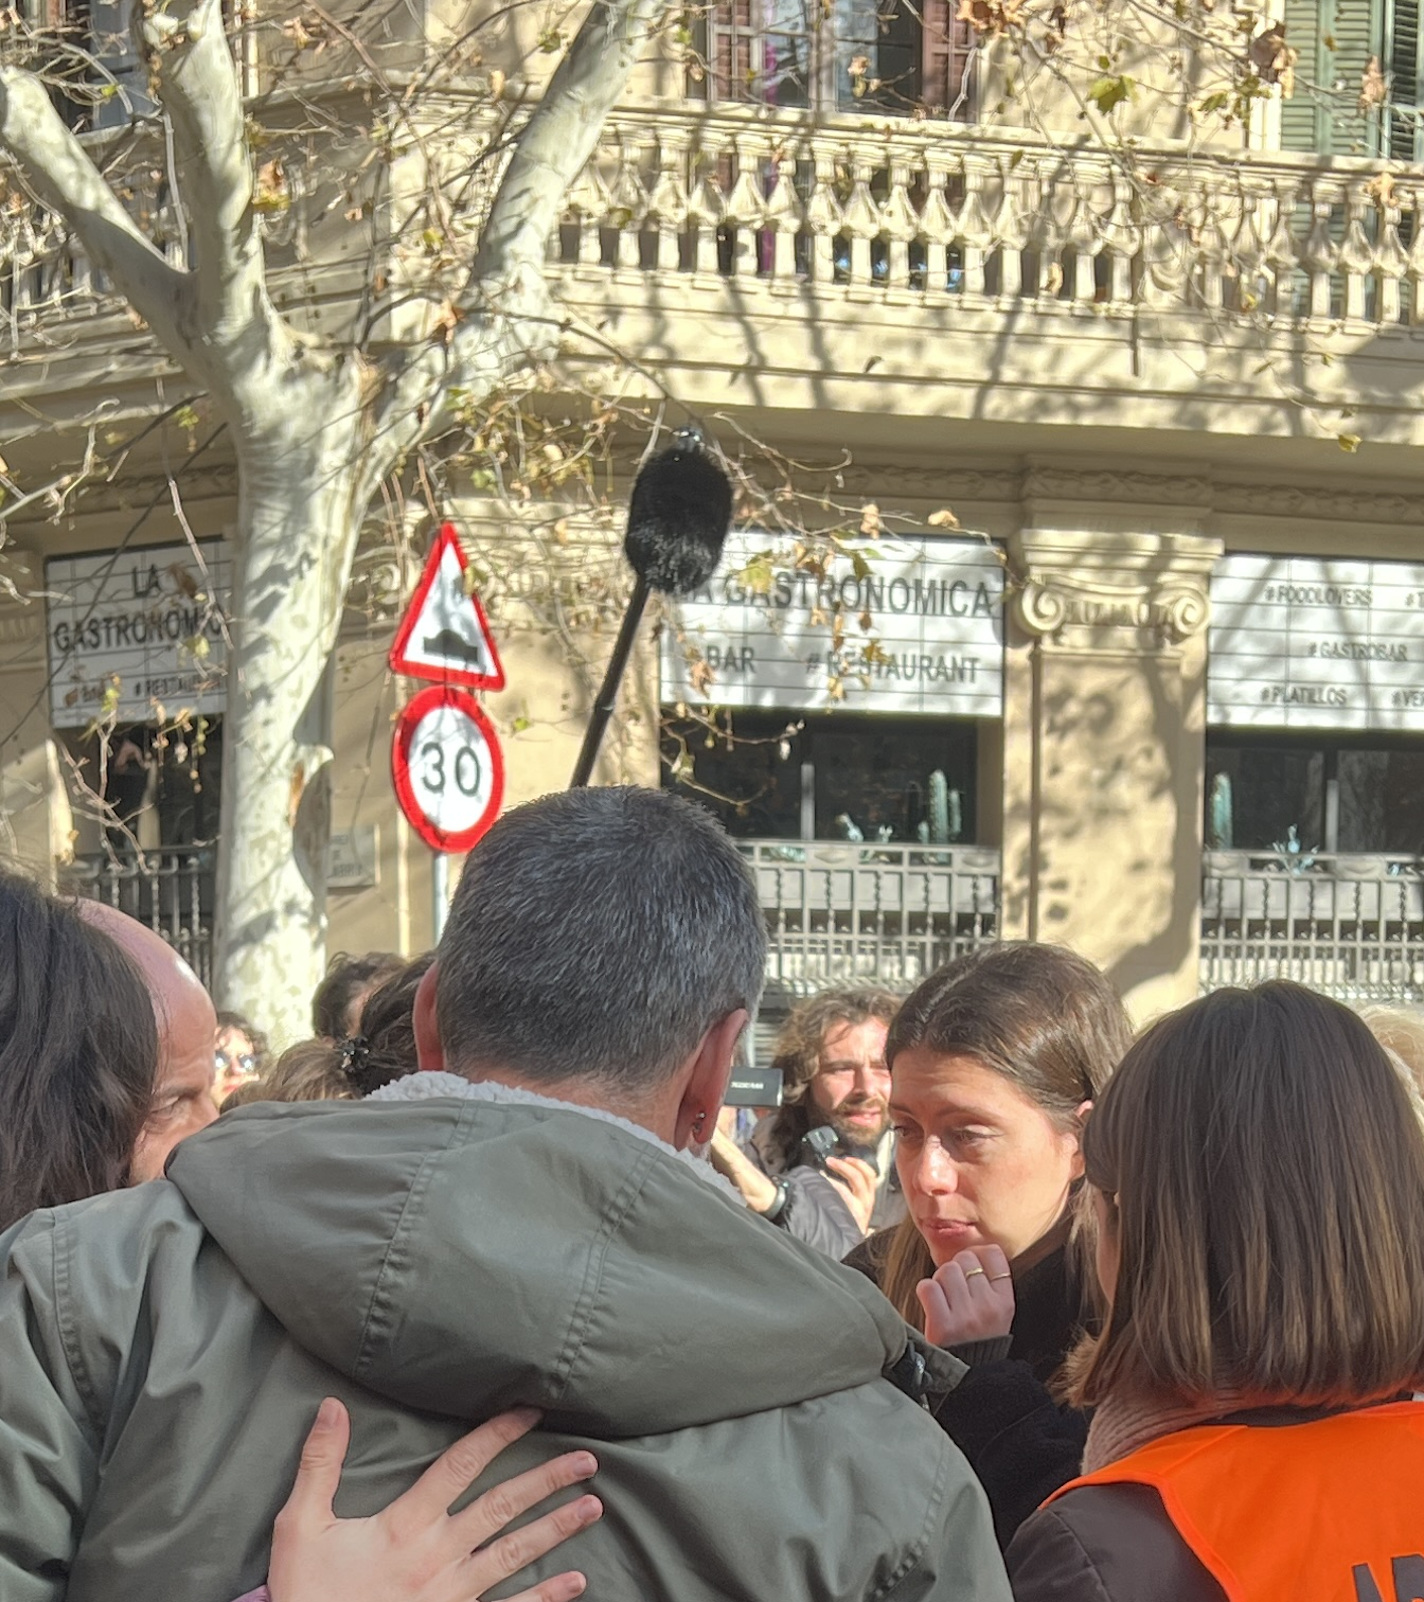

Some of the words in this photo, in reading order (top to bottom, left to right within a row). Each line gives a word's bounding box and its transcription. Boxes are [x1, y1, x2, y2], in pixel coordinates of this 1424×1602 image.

[132, 564, 162, 598] LA
[706, 645, 756, 673] BAR
[421, 741, 481, 797] 30
